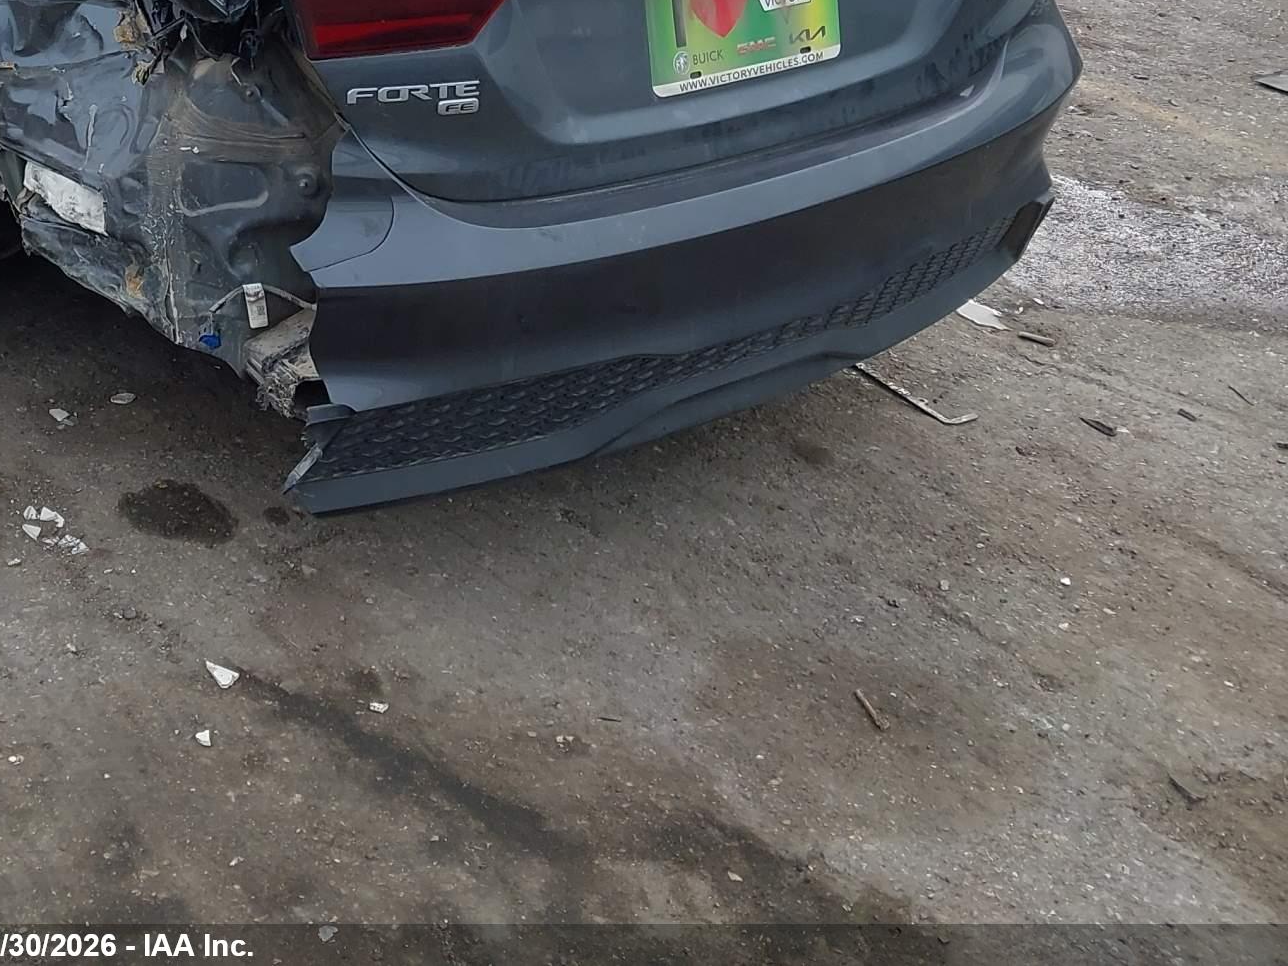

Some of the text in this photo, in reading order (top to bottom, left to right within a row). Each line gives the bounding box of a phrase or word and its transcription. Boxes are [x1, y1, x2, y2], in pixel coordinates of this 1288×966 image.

[789, 25, 826, 44] KIA
[692, 50, 724, 66] BUICK
[679, 52, 824, 92] WWW.VICTORYVEHICLES.COM
[346, 80, 480, 105] FORTE
[444, 101, 475, 114] FE
